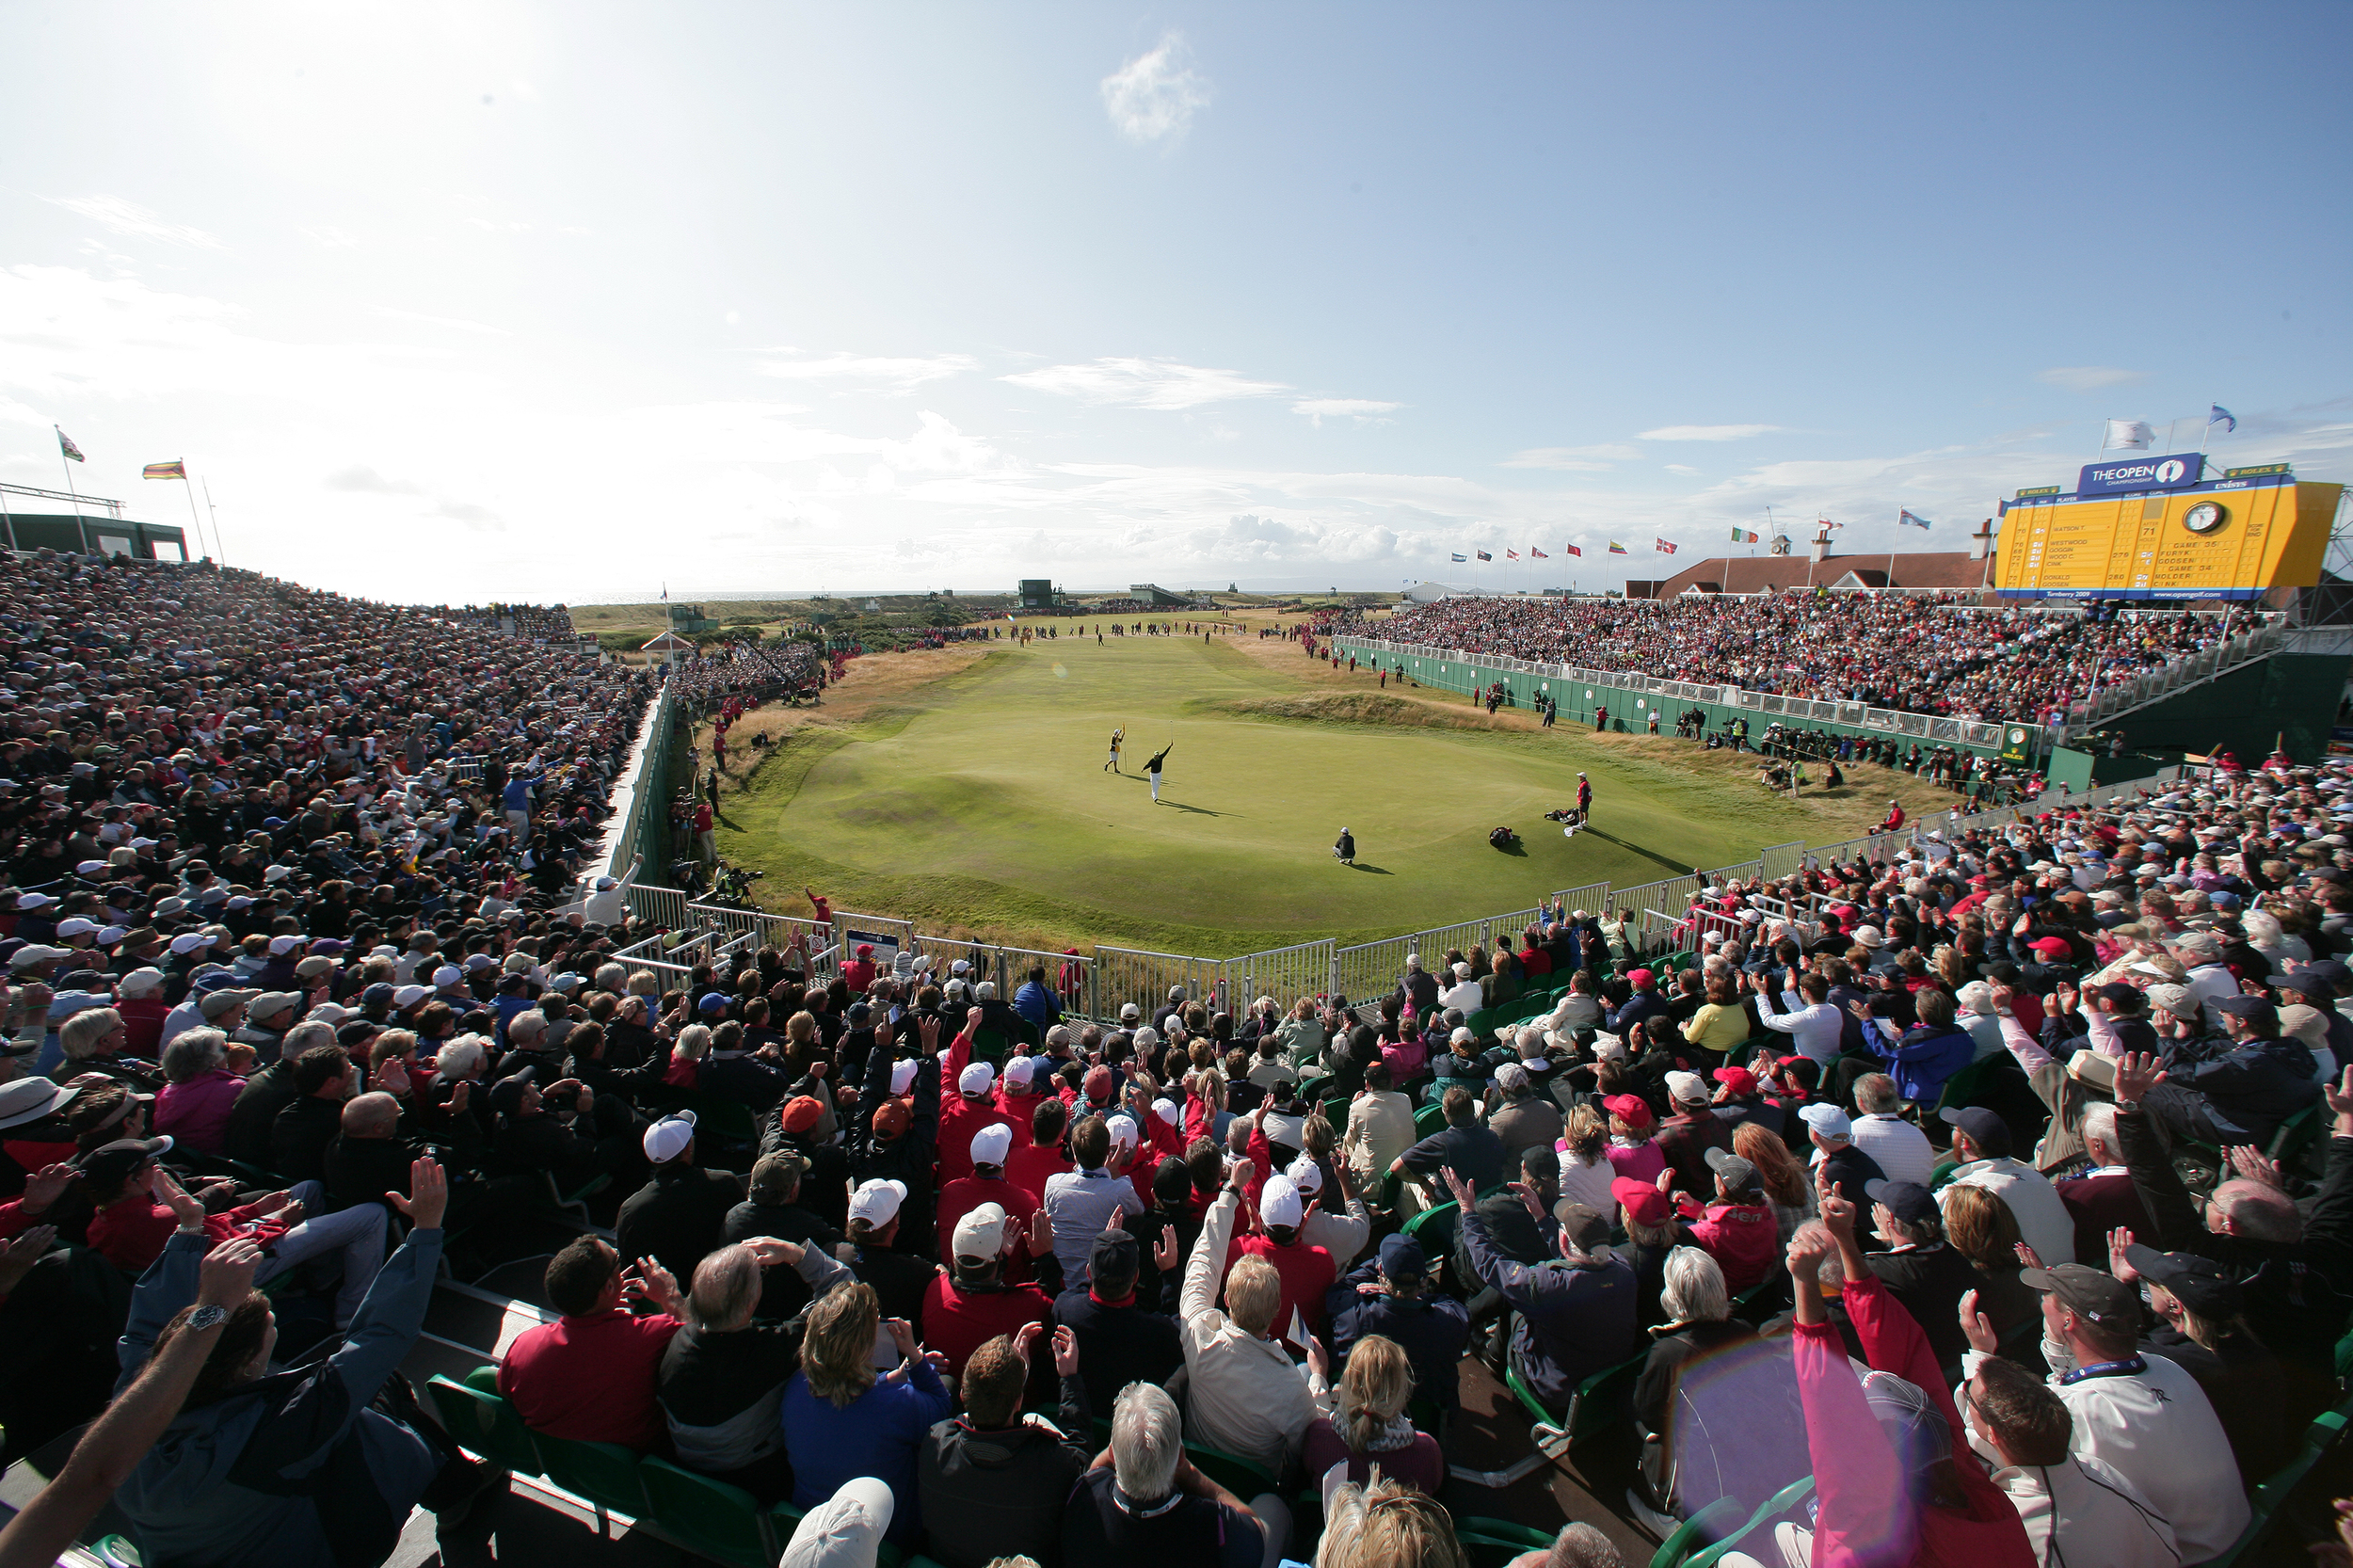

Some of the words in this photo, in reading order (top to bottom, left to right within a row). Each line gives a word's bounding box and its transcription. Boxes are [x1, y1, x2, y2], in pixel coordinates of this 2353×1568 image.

[2092, 469, 2115, 482] THE
[2115, 464, 2155, 479] OPEN
[2240, 466, 2272, 475] ROLEX
[2106, 476, 2153, 487] CHAMPIONSHIP
[2142, 527, 2155, 536] 71
[2002, 752, 2025, 760] ROLEX
